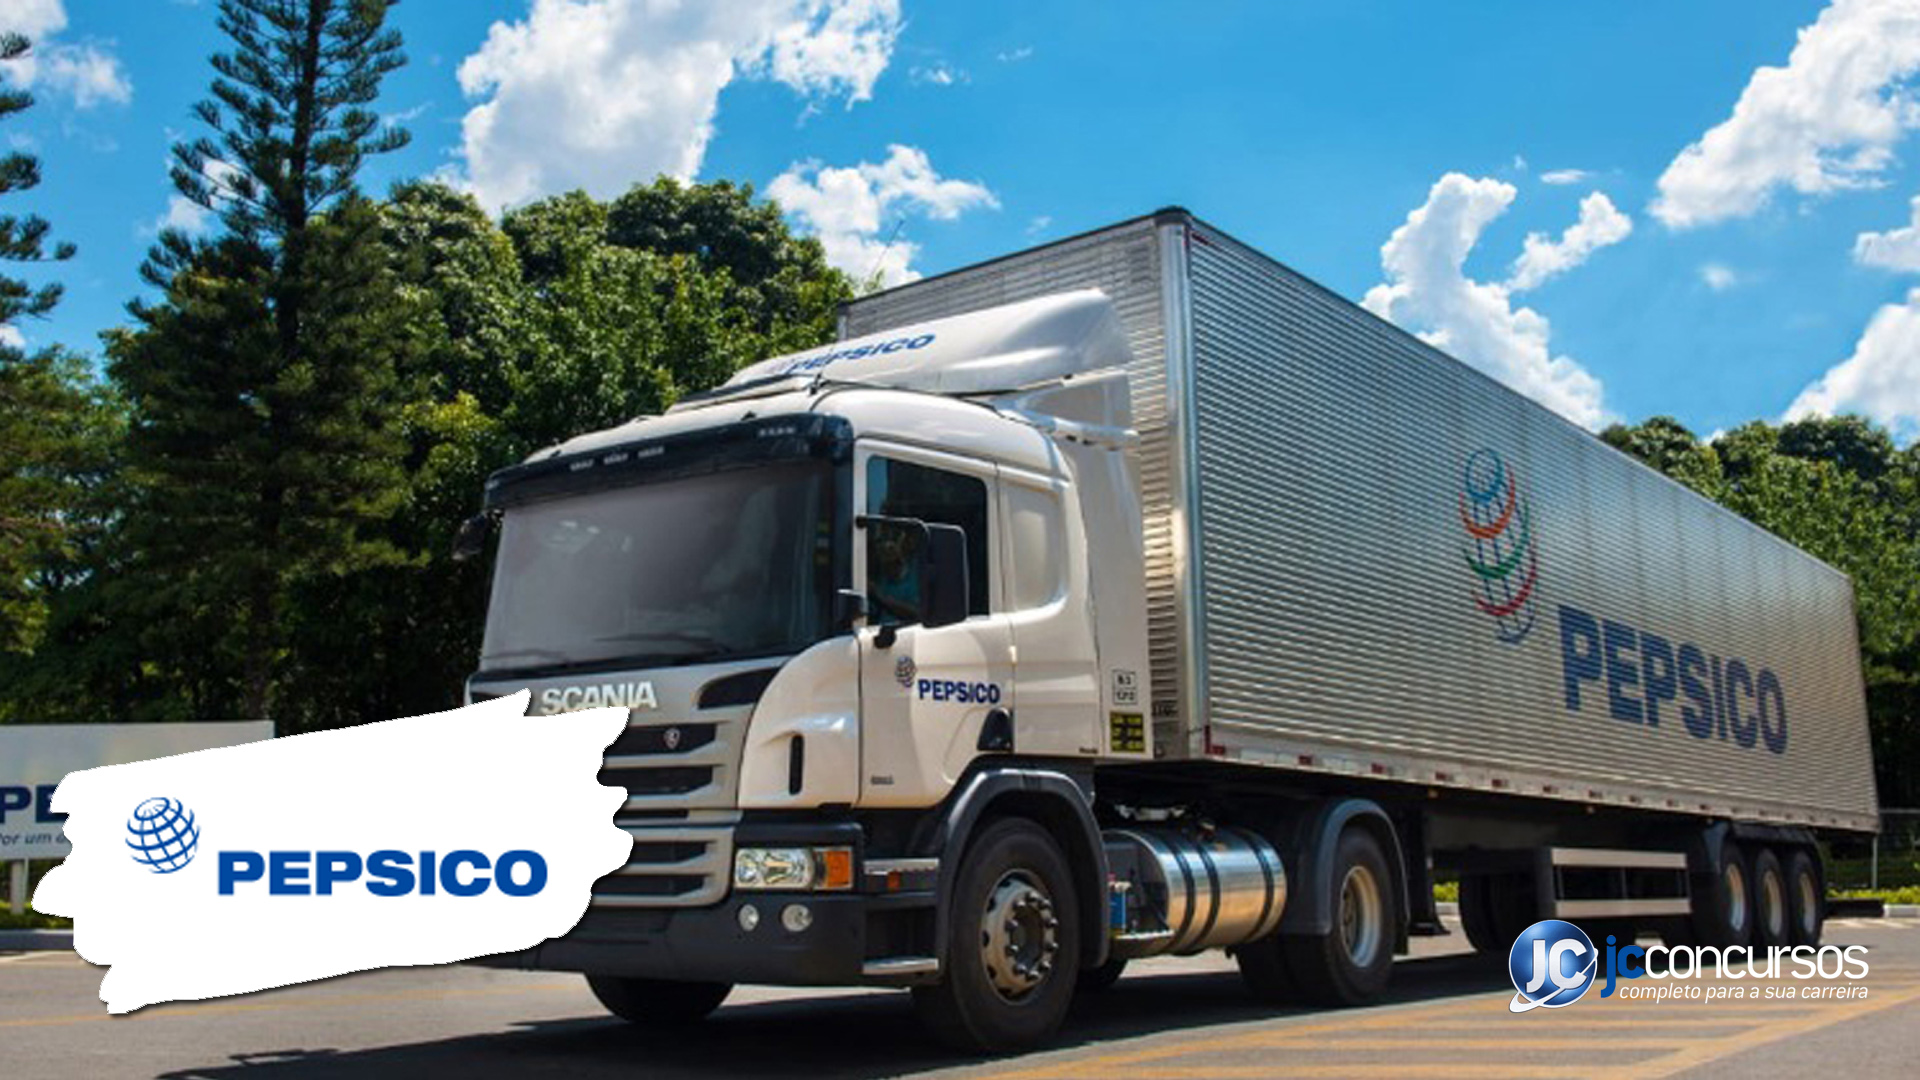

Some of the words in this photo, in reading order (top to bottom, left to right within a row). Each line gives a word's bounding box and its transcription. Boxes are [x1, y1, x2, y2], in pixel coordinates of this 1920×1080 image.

[783, 334, 936, 375] PEPSICO
[918, 679, 1000, 704] PEPSICO
[1559, 604, 1787, 755] PEPSICO
[540, 681, 658, 715] SCANIA
[0, 833, 20, 846] or
